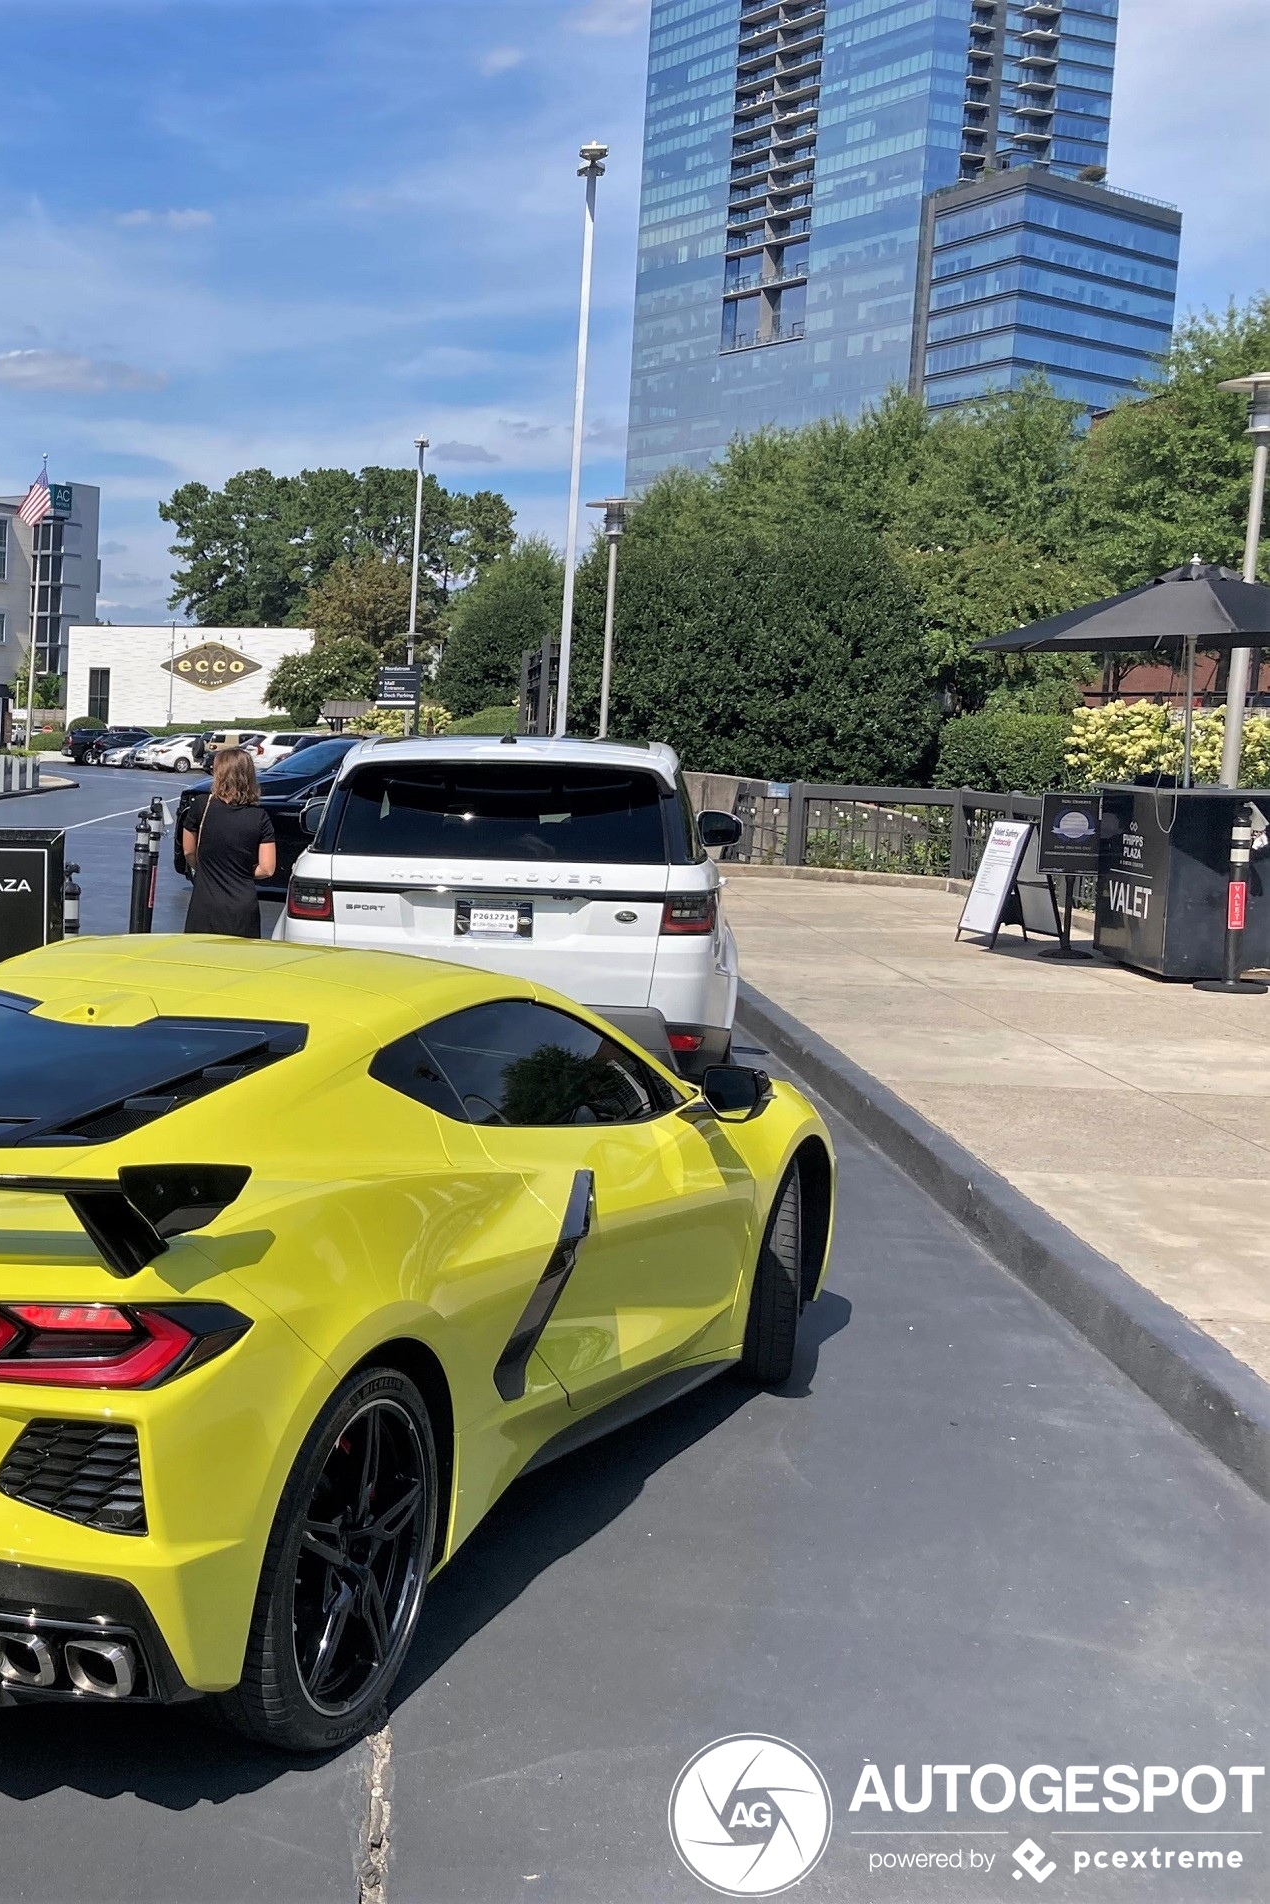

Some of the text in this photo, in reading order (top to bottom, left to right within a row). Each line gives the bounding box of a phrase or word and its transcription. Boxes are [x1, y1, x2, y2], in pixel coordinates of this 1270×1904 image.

[56, 489, 70, 502] AC
[178, 660, 245, 673] ecco
[994, 827, 1020, 839] Valet Safety
[1123, 833, 1144, 847] PHIPPS
[1123, 846, 1142, 859] PLAZA
[390, 868, 603, 884] RANGE ROVER
[1109, 880, 1152, 919] VALET
[345, 903, 386, 911] SPORT
